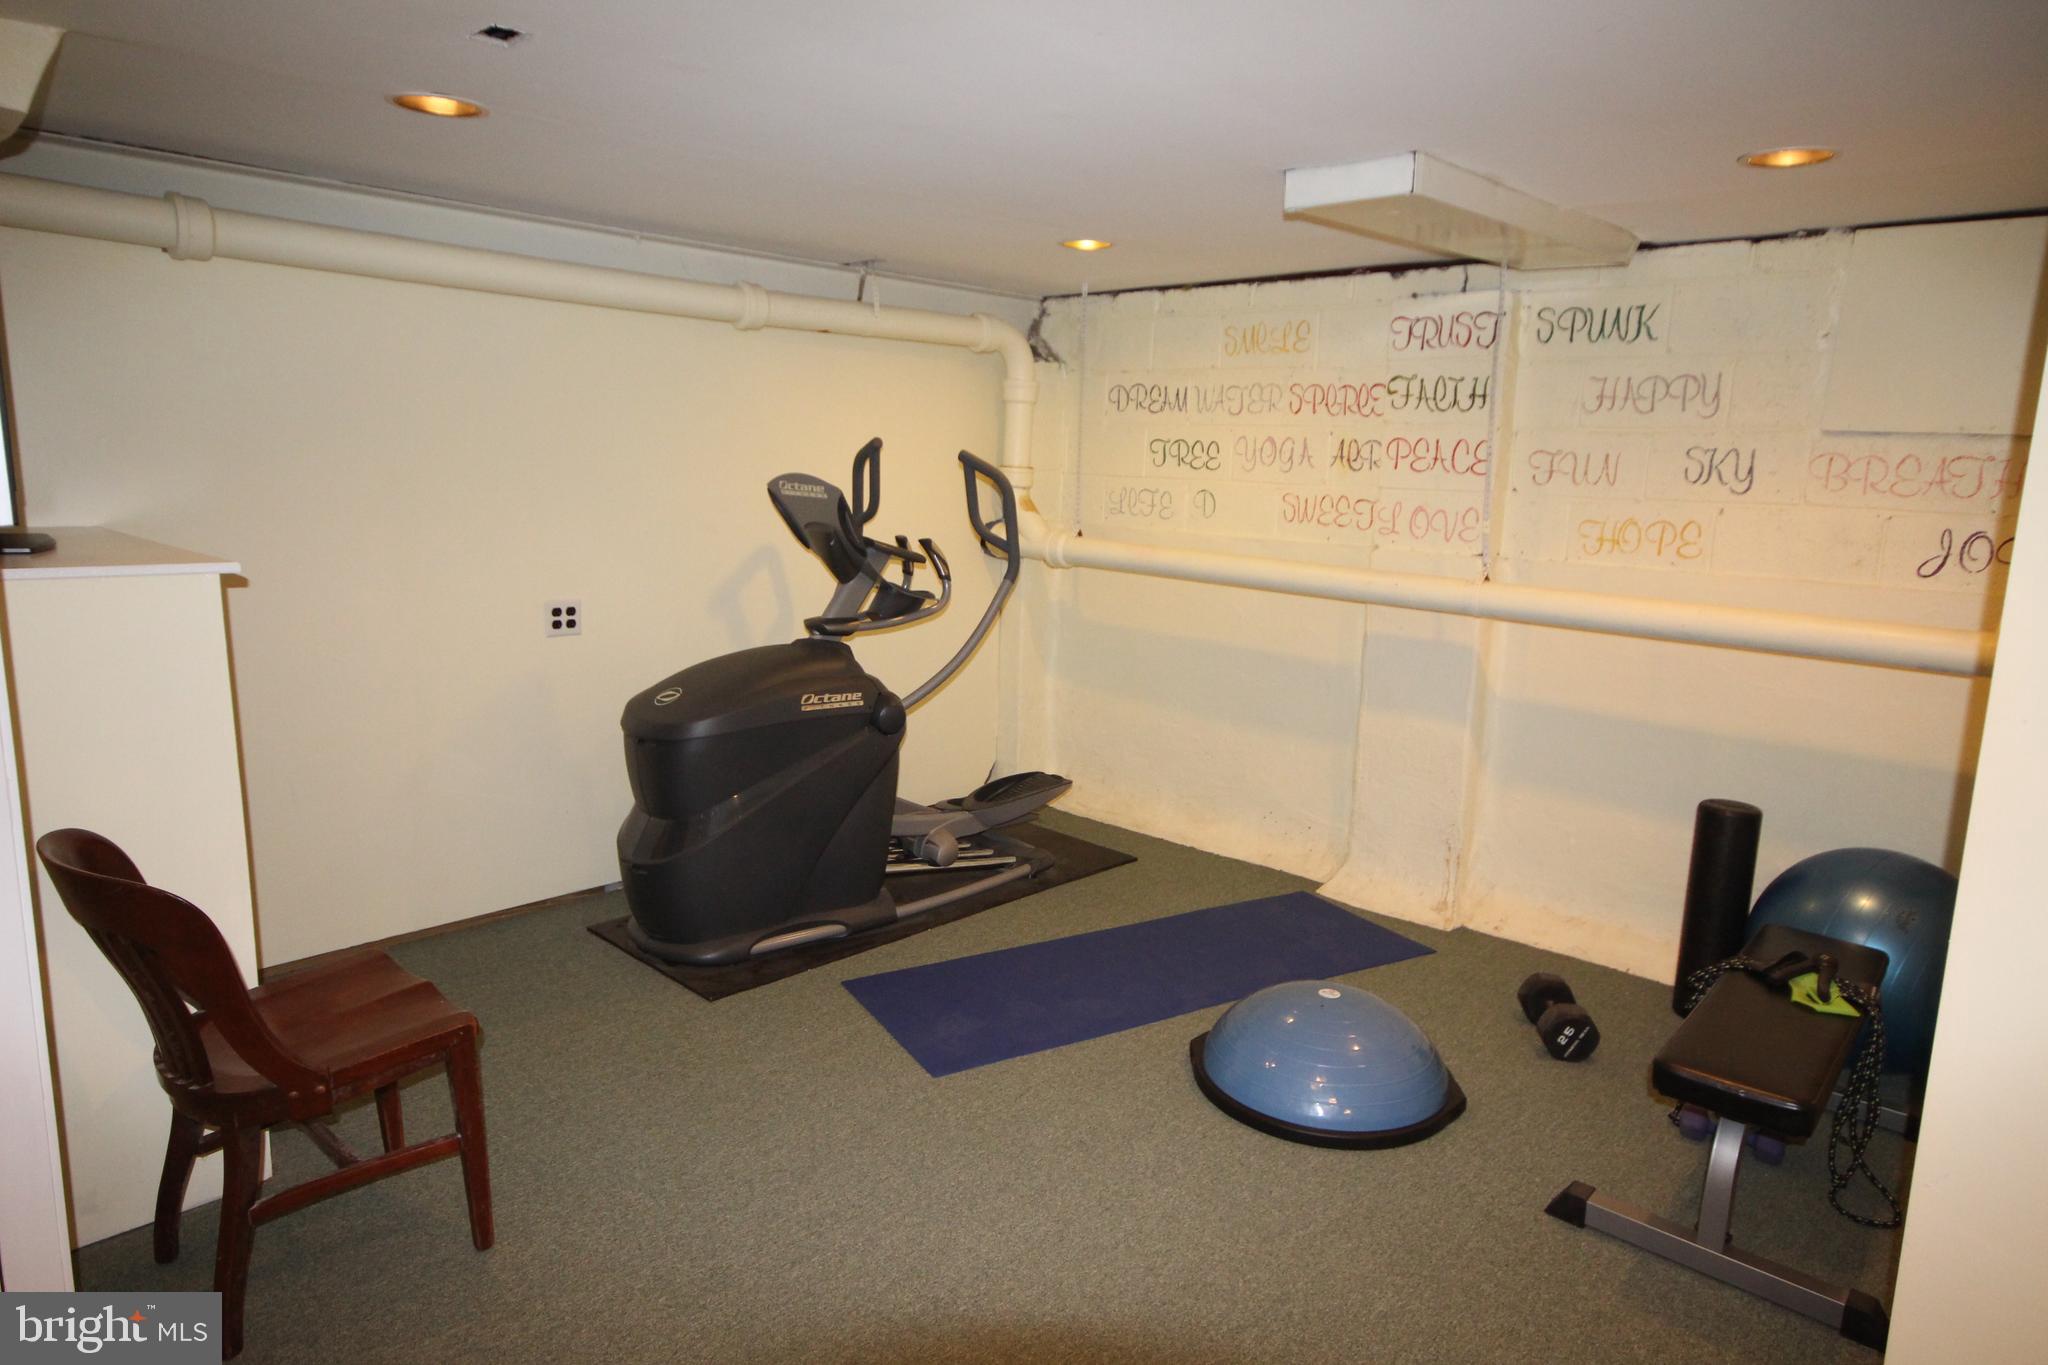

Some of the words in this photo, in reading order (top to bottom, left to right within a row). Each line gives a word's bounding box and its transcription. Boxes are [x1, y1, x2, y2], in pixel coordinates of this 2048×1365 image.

[1390, 311, 1502, 351] TRUST
[1536, 303, 1661, 344] SPUNK
[1108, 382, 1188, 414] DREAM
[1192, 382, 1283, 417] WATER
[1386, 374, 1491, 413] FAITH
[1581, 371, 1723, 419] HAPPY
[1150, 437, 1221, 472] TREE
[1232, 435, 1315, 474] YOGA
[1386, 436, 1488, 476] PEACE
[1528, 448, 1622, 487] FUN
[1684, 446, 1756, 496] SKY
[779, 480, 825, 493] Octane
[1281, 492, 1378, 531] SWEET
[1378, 502, 1481, 543] LOVE
[1577, 517, 1703, 559] HOPE
[800, 692, 863, 705] Octane
[1557, 1026, 1575, 1046] 25
